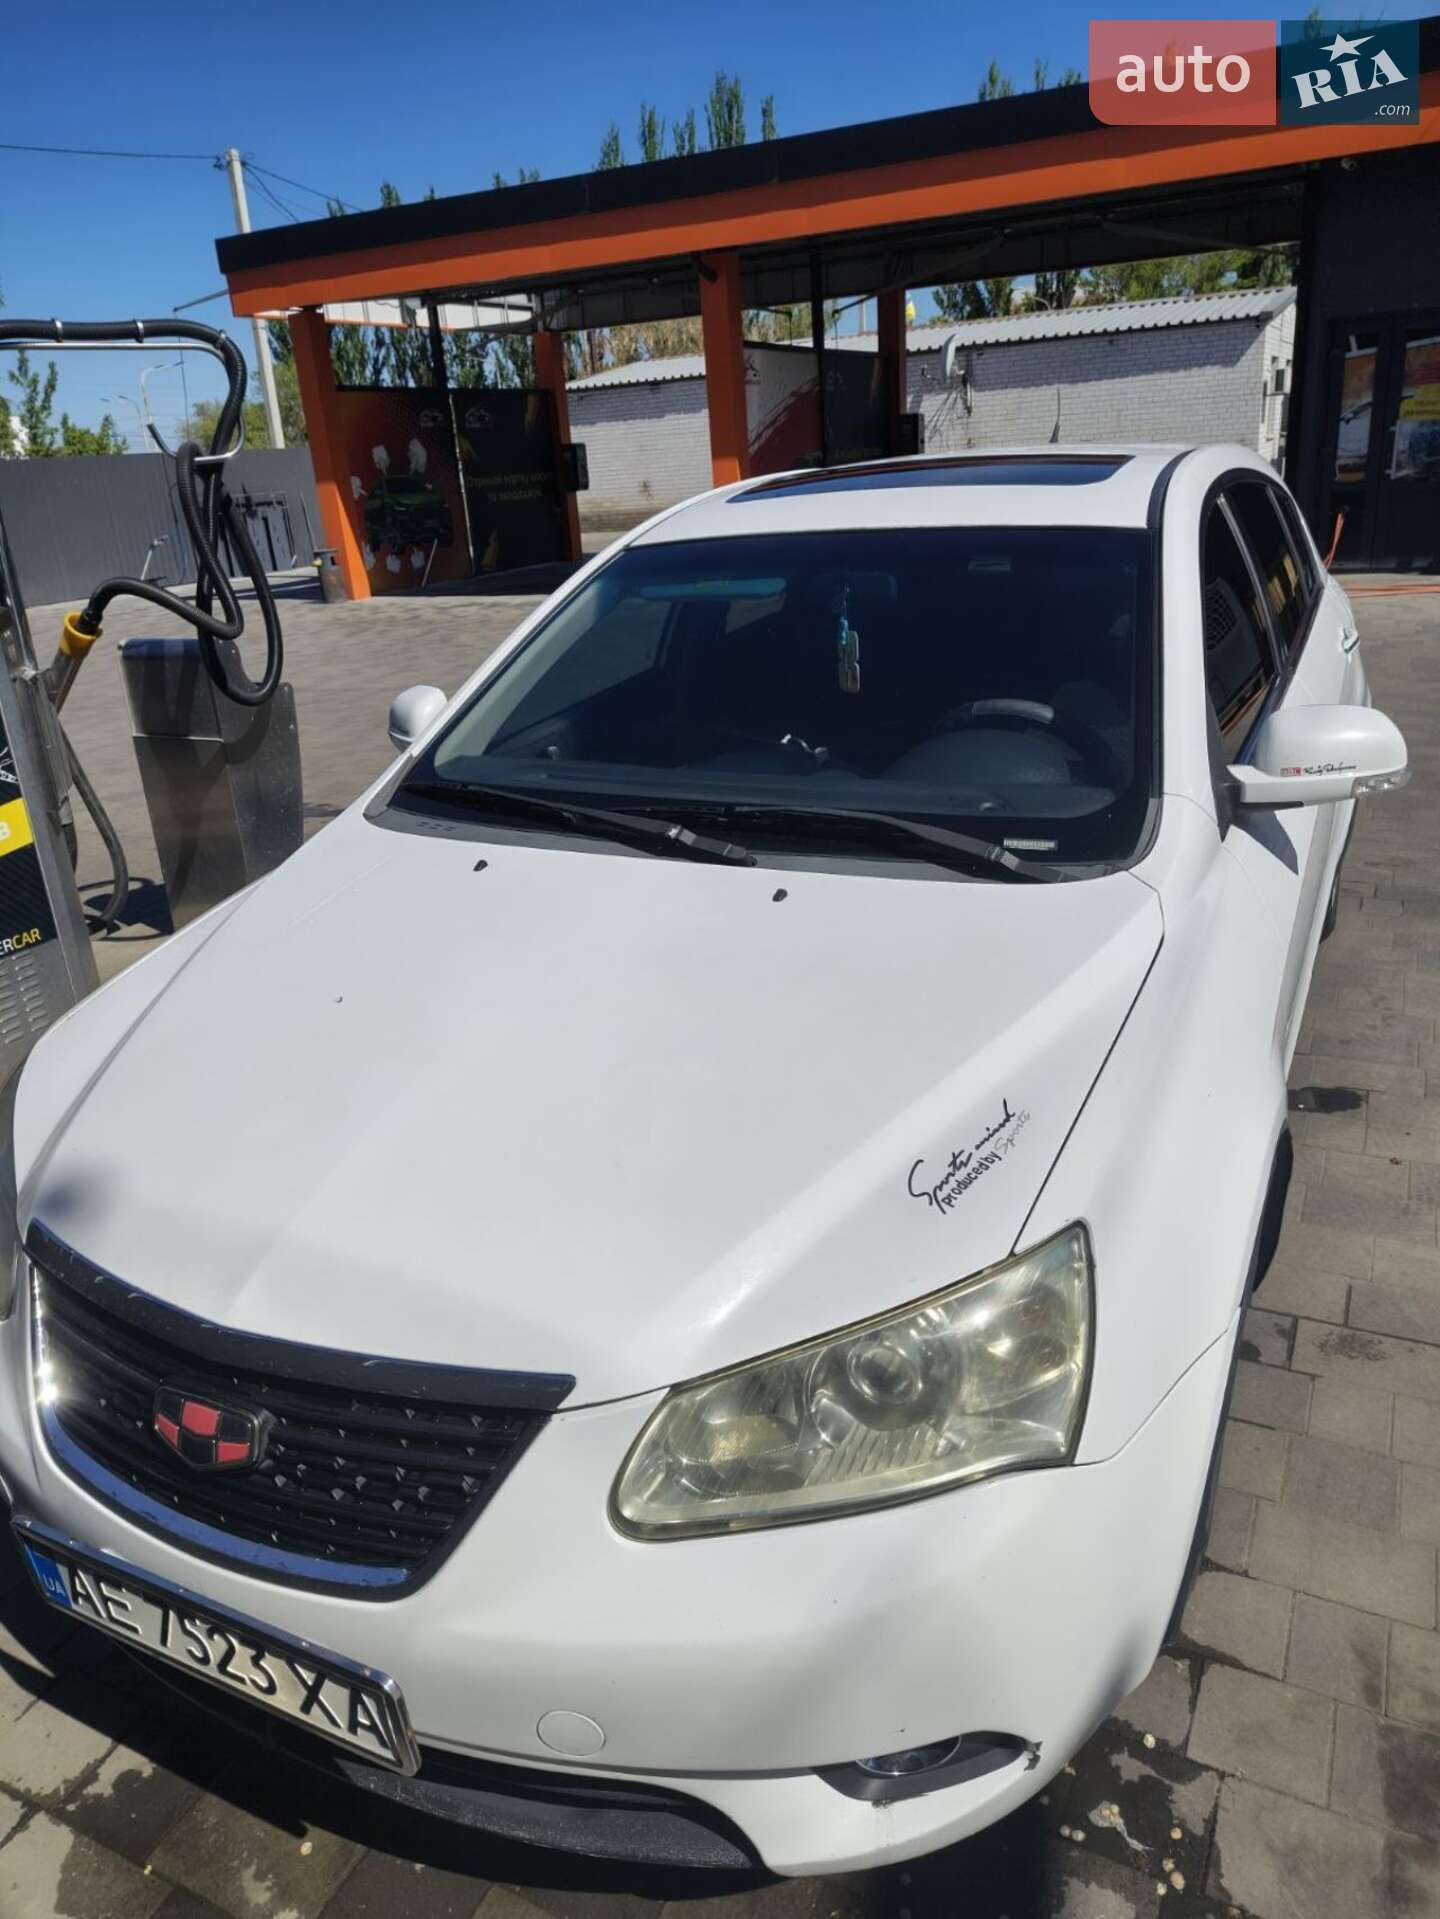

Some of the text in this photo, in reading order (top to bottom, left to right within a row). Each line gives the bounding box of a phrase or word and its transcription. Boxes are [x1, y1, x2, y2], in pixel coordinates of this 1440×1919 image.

[42, 1574, 66, 1597] UA
[69, 1564, 143, 1635] AE
[285, 1658, 393, 1751] XA
